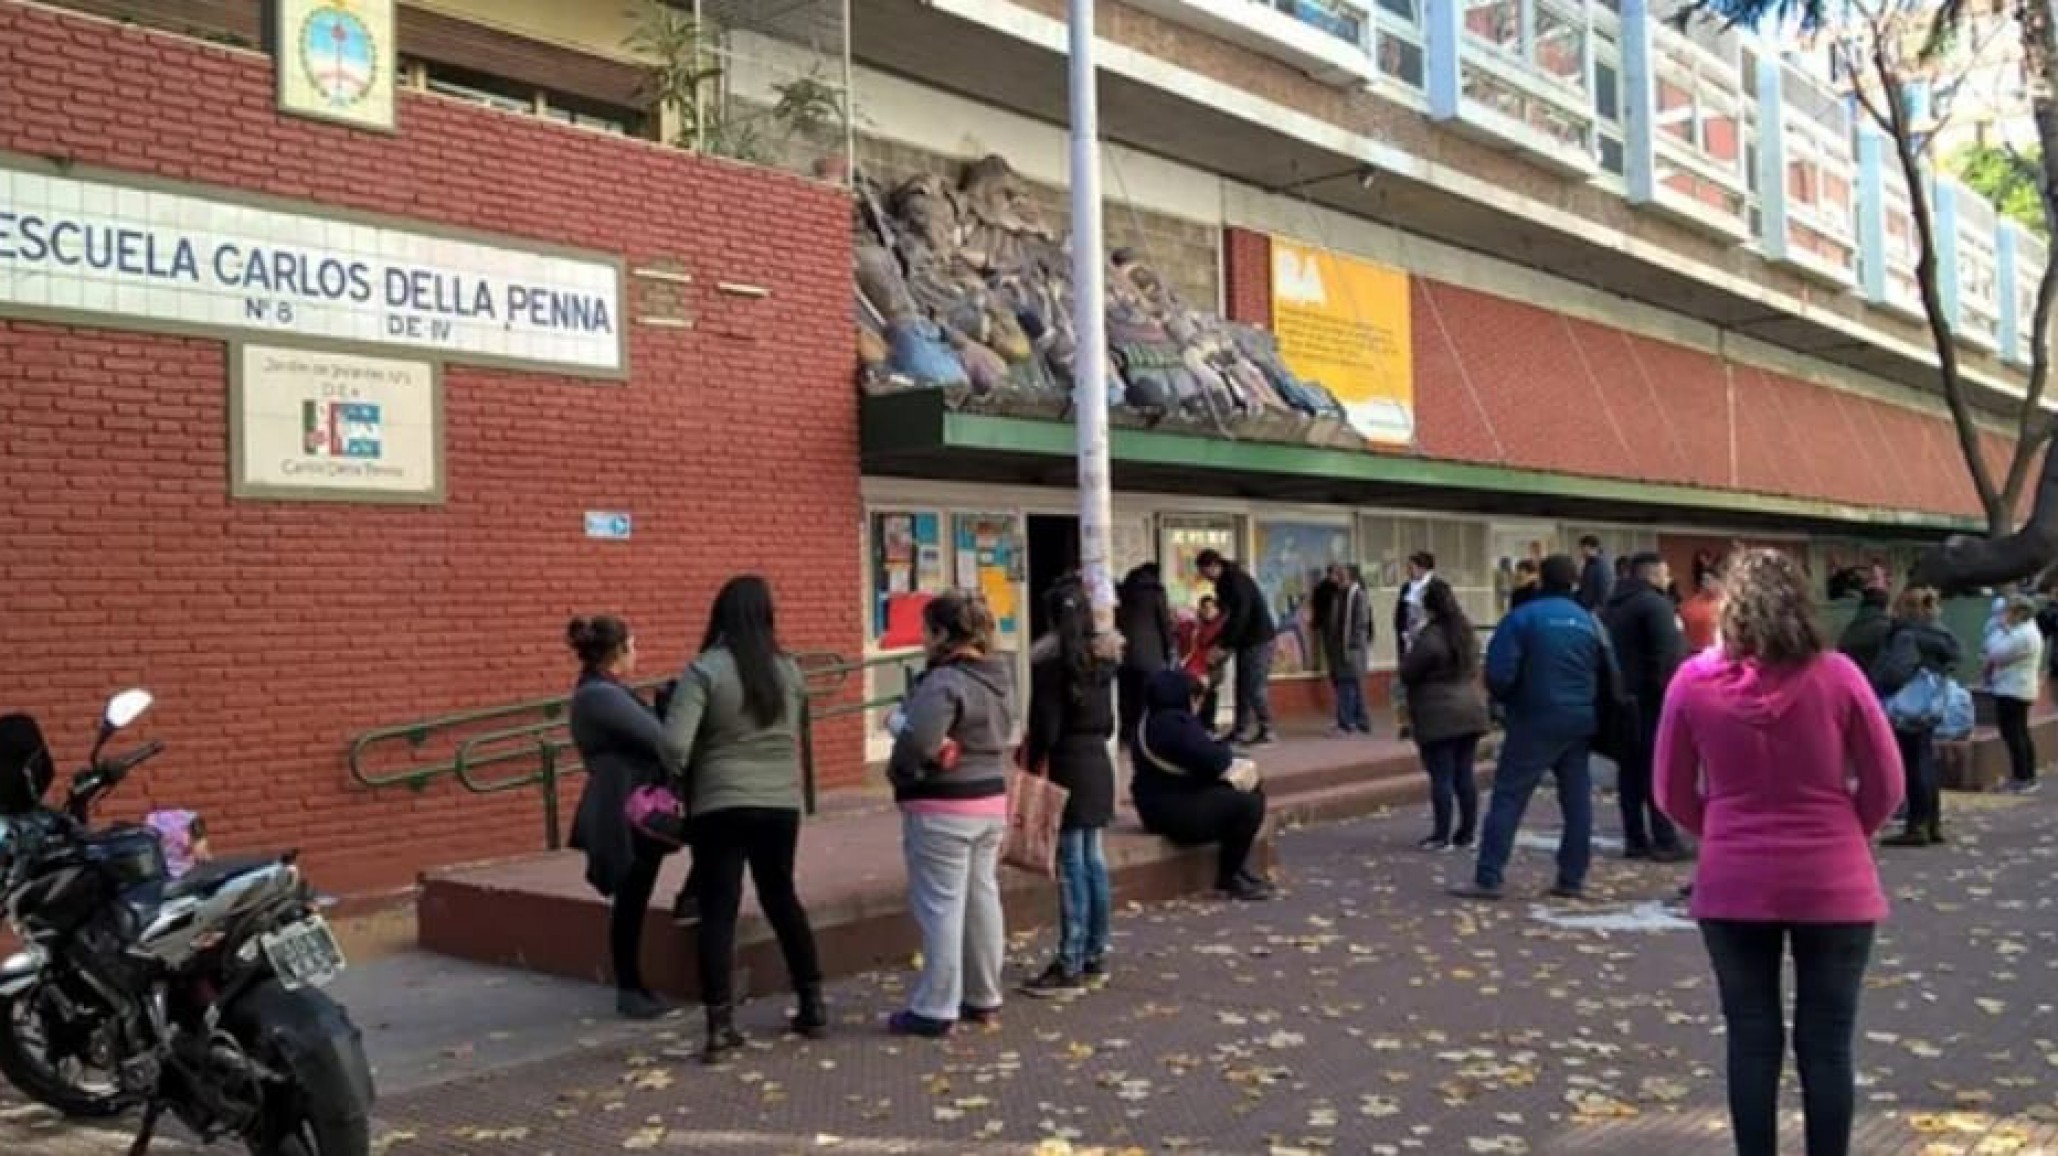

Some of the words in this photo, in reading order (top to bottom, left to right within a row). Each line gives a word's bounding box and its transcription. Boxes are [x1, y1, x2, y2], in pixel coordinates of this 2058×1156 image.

[0, 212, 199, 282] ESCUELA
[213, 243, 371, 302] CARLOS
[384, 266, 496, 319] DELLA
[506, 284, 612, 334] PENNA
[276, 302, 294, 323] 8
[387, 314, 422, 338] DE
